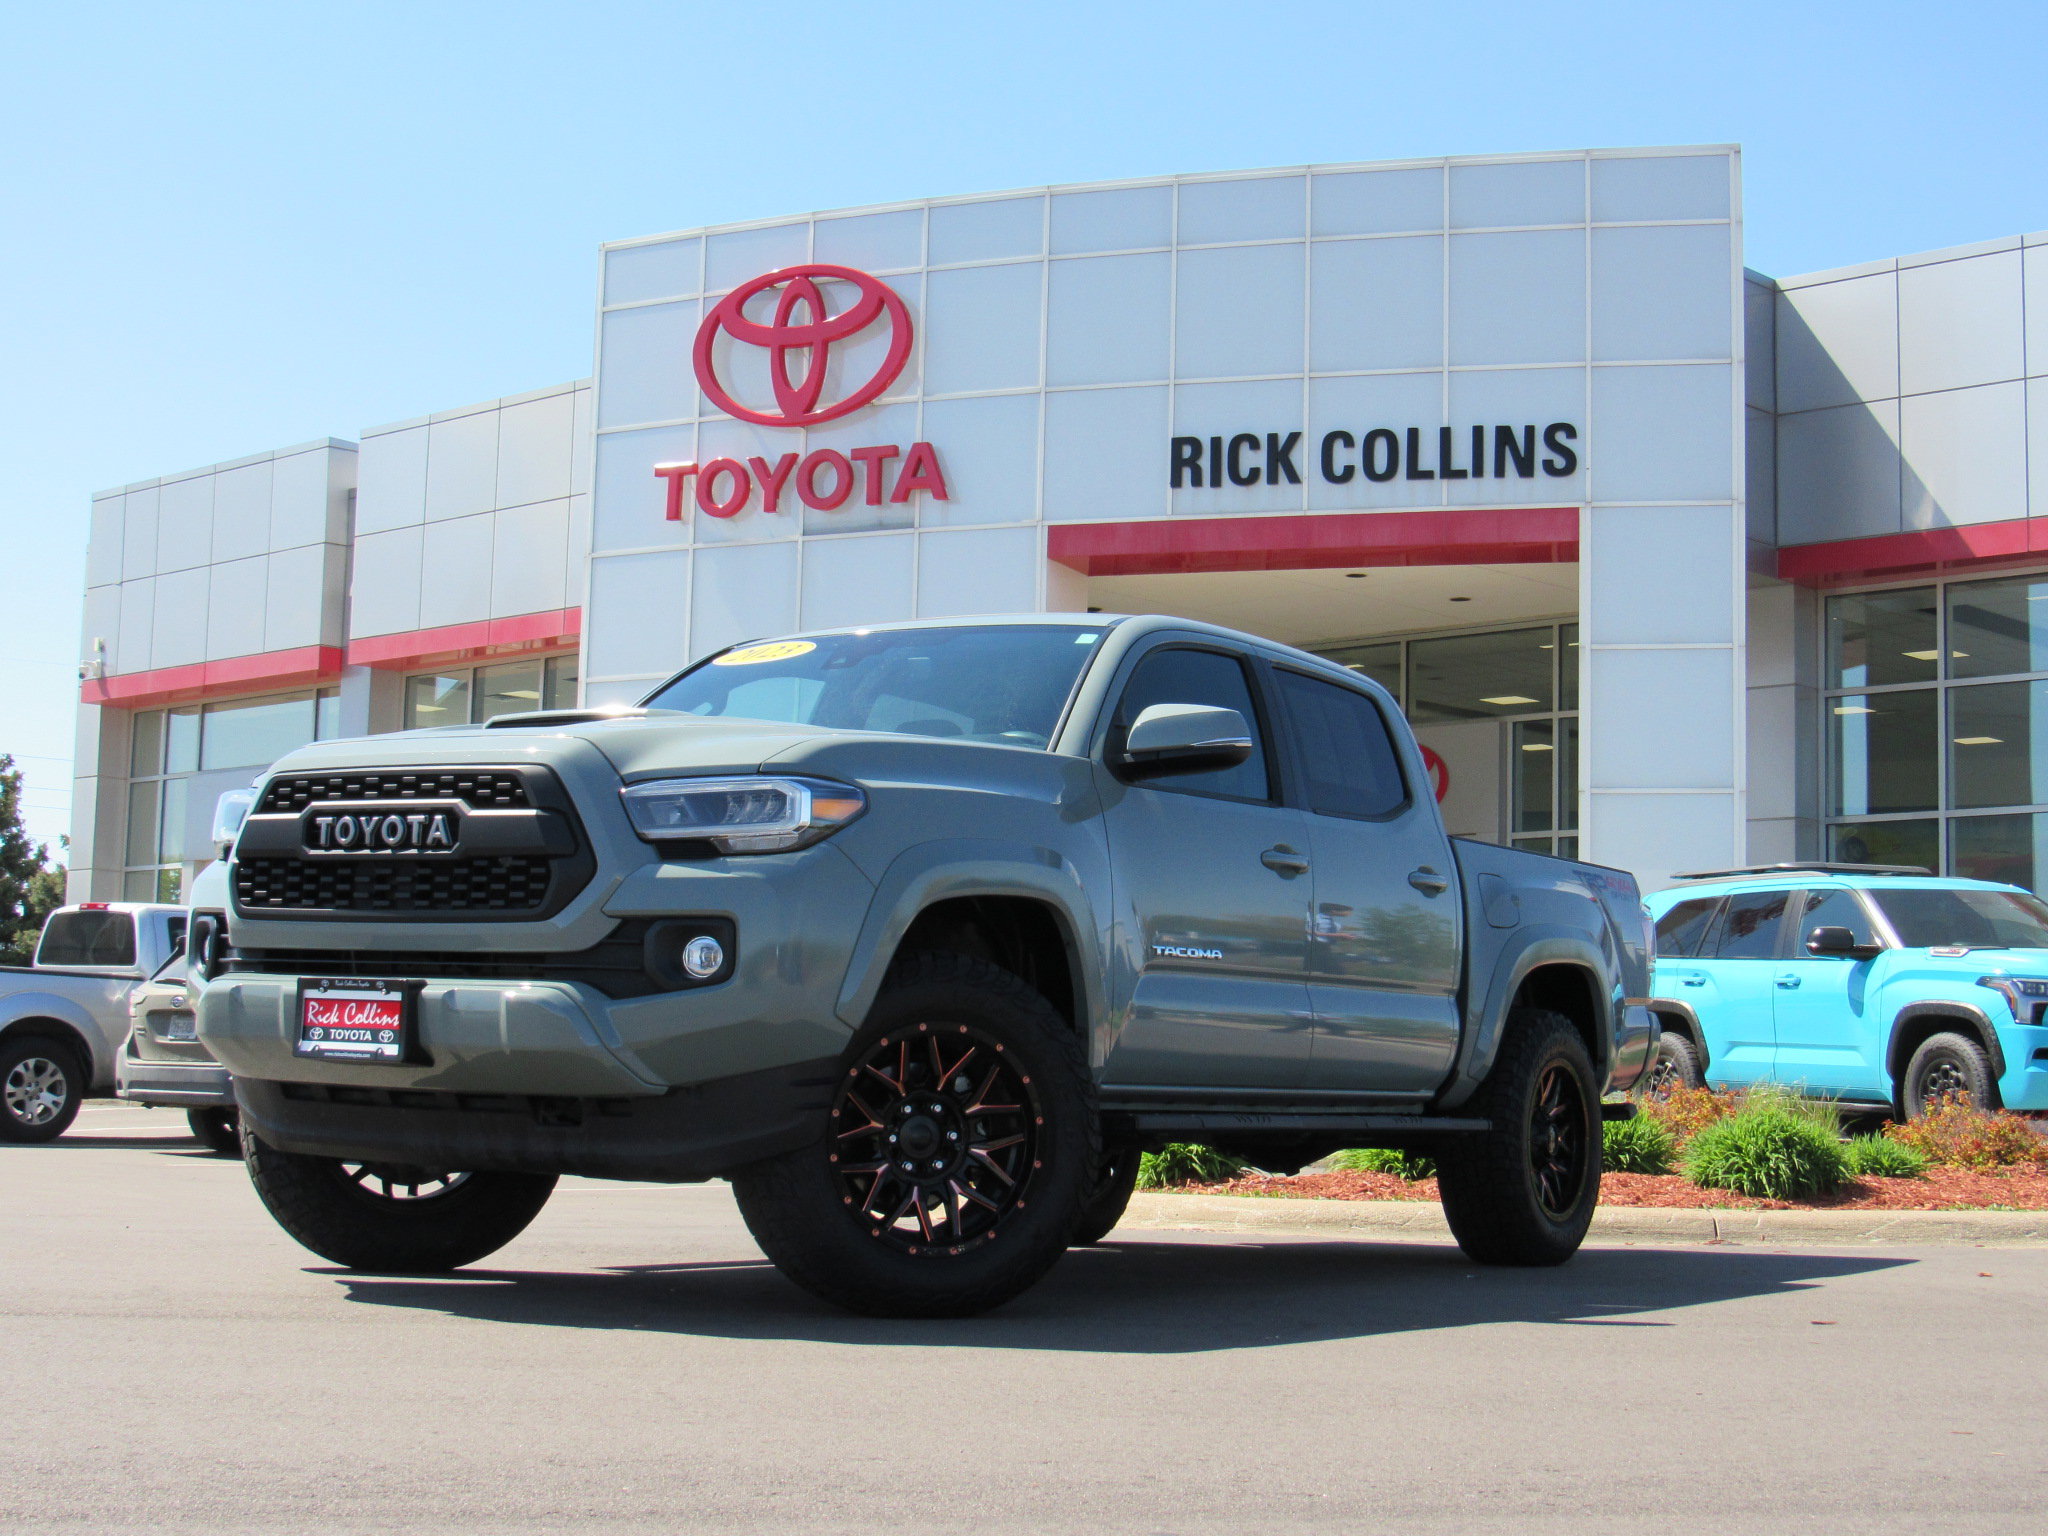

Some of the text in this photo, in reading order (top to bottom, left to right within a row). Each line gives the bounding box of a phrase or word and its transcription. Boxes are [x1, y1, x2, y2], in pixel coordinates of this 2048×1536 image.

[1170, 422, 1577, 488] RICK COLLINS
[654, 441, 951, 521] TOYOTA
[315, 814, 453, 847] TOYOTA
[1152, 945, 1223, 960] TACOMA
[307, 1001, 400, 1026] Rick Collins
[329, 1028, 372, 1041] TOYOTA
